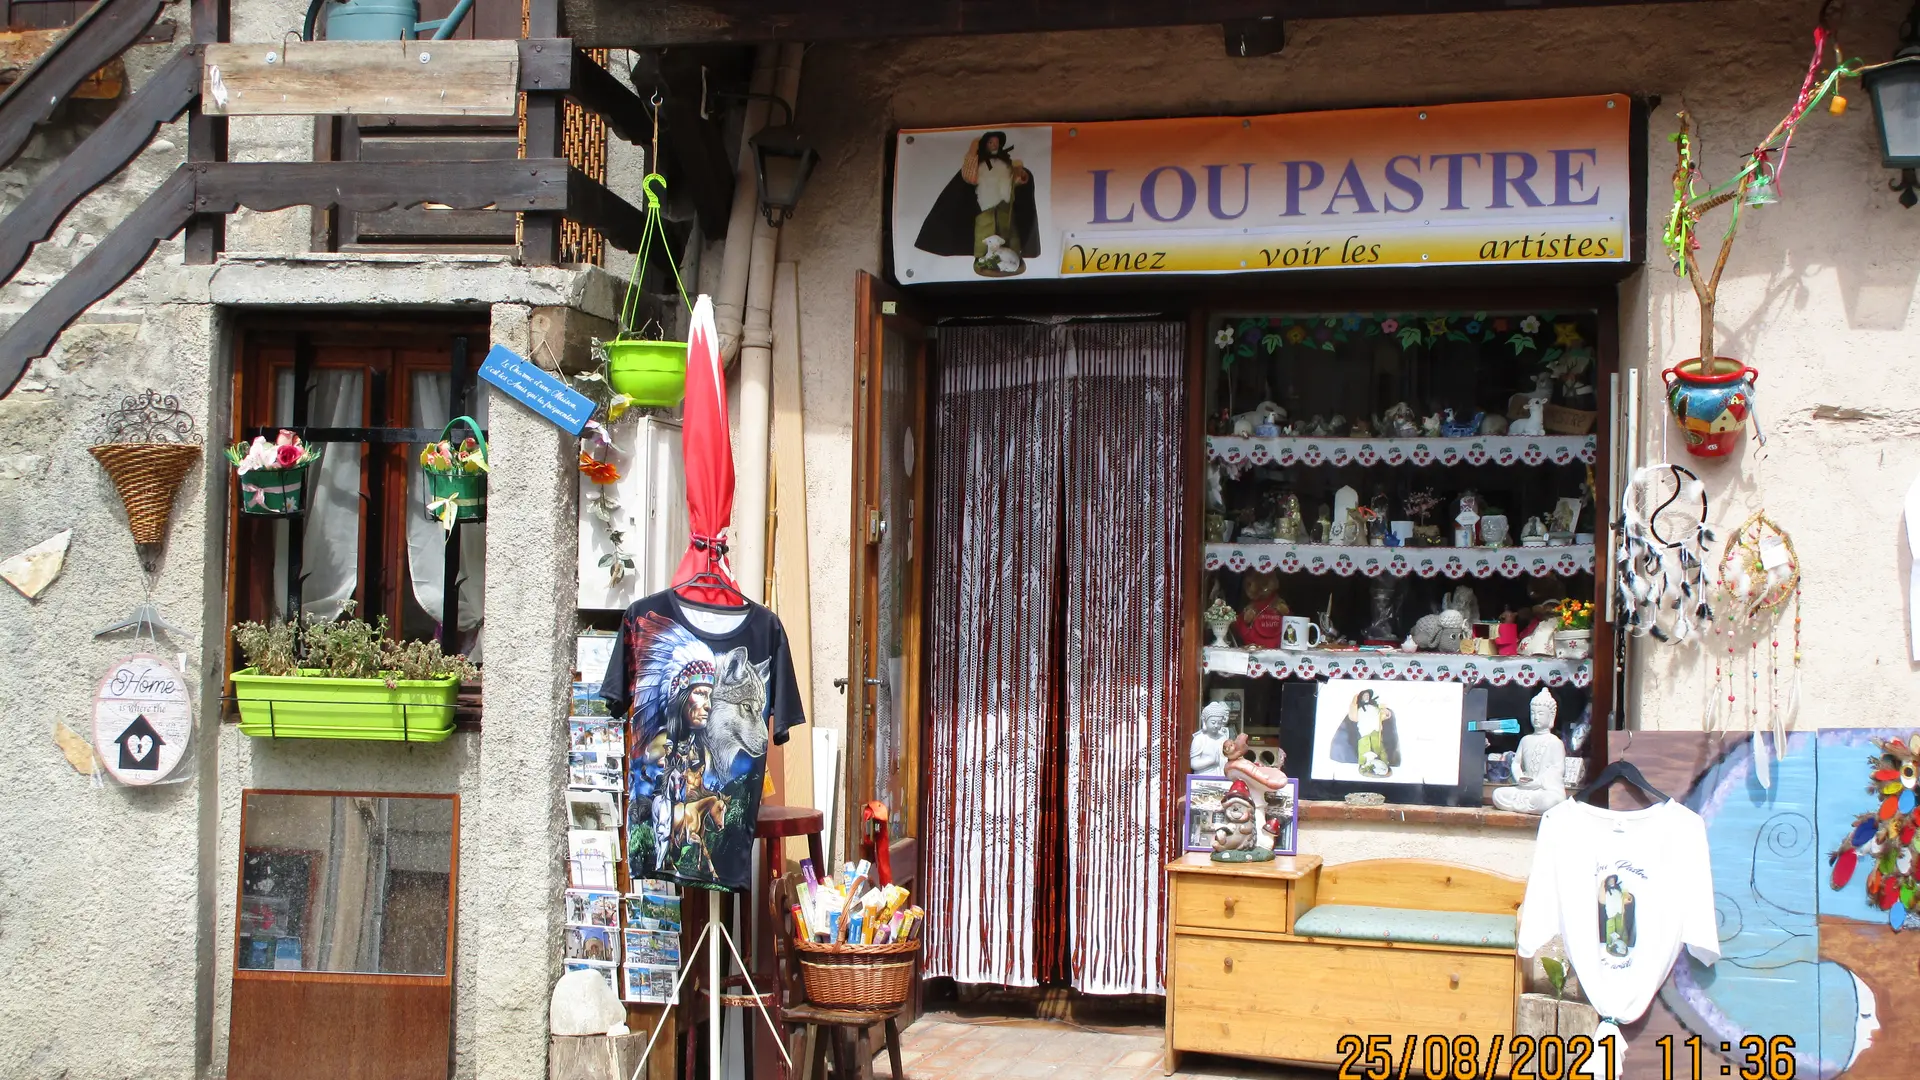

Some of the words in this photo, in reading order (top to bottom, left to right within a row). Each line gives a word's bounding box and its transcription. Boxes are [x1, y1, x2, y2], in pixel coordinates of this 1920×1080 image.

[1087, 162, 1256, 224] LOU
[1279, 148, 1600, 217] PASTRE
[1069, 244, 1167, 271] Venez
[1259, 240, 1330, 266] voir
[1341, 235, 1381, 263] les
[1479, 232, 1609, 259] artistes
[506, 378, 528, 394] Amis
[526, 390, 540, 400] qui
[110, 668, 177, 697] Home
